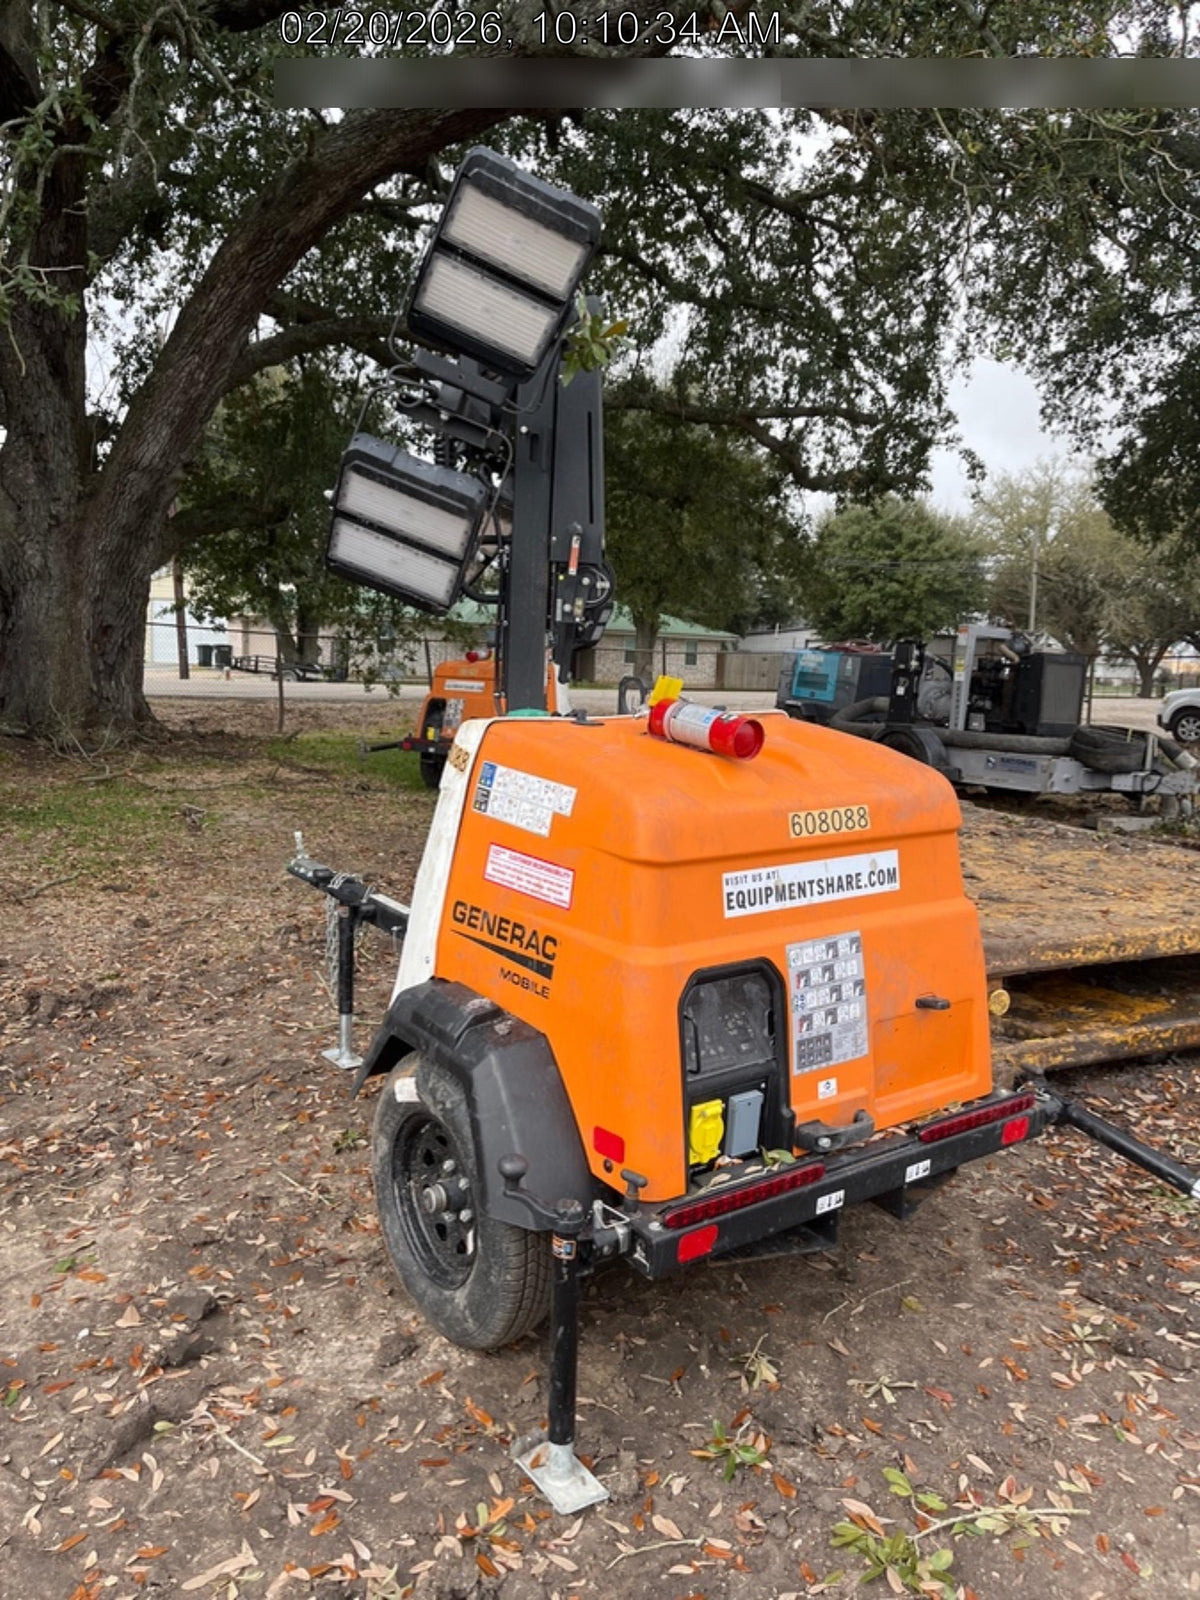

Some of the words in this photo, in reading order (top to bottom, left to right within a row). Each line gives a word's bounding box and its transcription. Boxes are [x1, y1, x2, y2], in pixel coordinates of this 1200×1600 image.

[791, 806, 869, 837] 608088
[725, 874, 748, 887] VISIT
[752, 872, 763, 883] US
[726, 867, 897, 911] EQUIPMENTSHARE.COM
[452, 900, 558, 961] GENERAC
[499, 967, 550, 999] MOBILE
